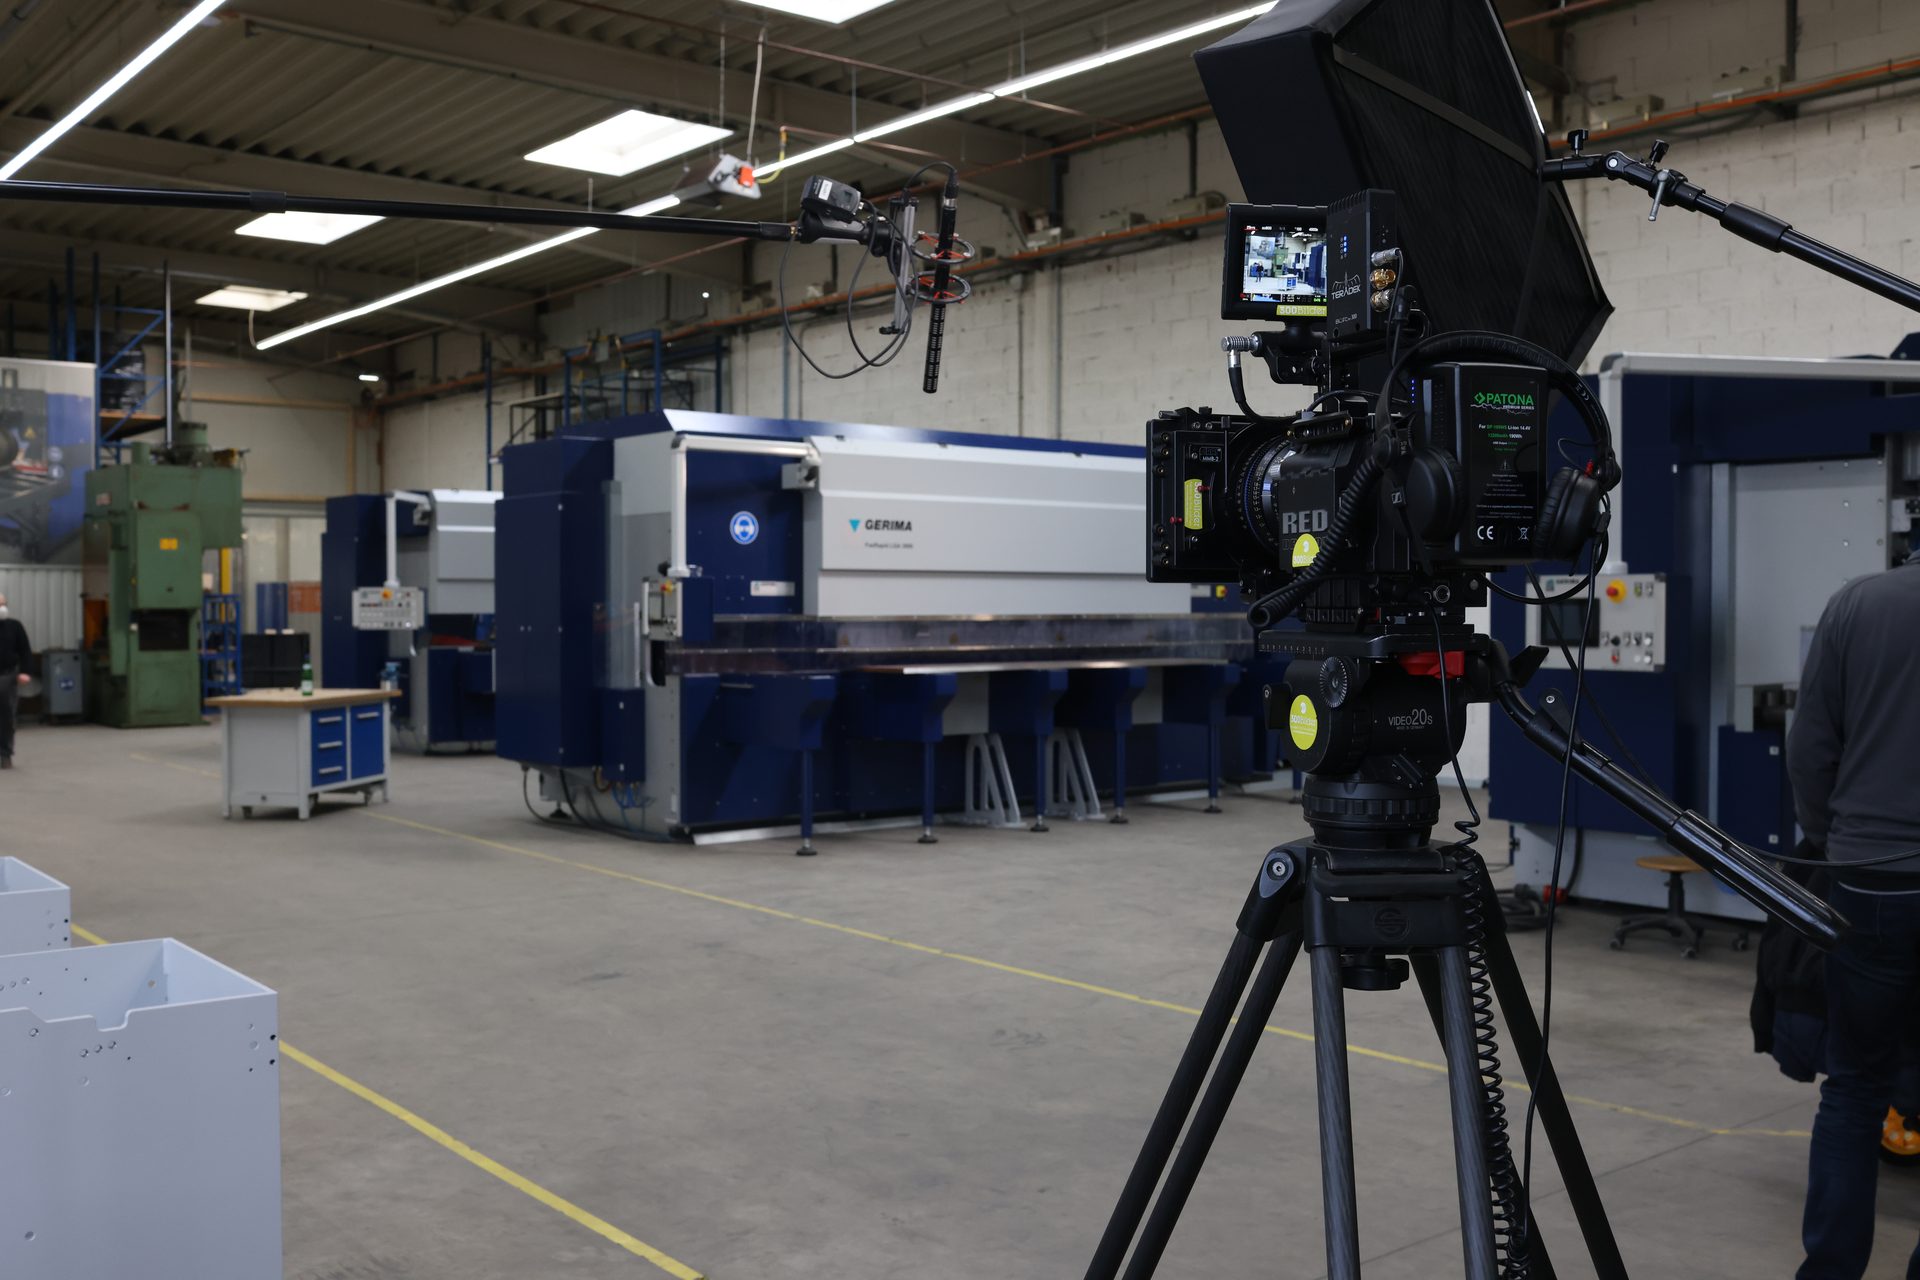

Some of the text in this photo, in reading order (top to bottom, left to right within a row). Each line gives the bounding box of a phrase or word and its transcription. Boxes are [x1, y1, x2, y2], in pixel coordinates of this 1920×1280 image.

[1331, 284, 1361, 300] TERADEK
[1486, 393, 1534, 405] PATONA
[865, 519, 912, 531] GERIMA
[1282, 509, 1328, 534] RED
[1477, 525, 1494, 540] CE
